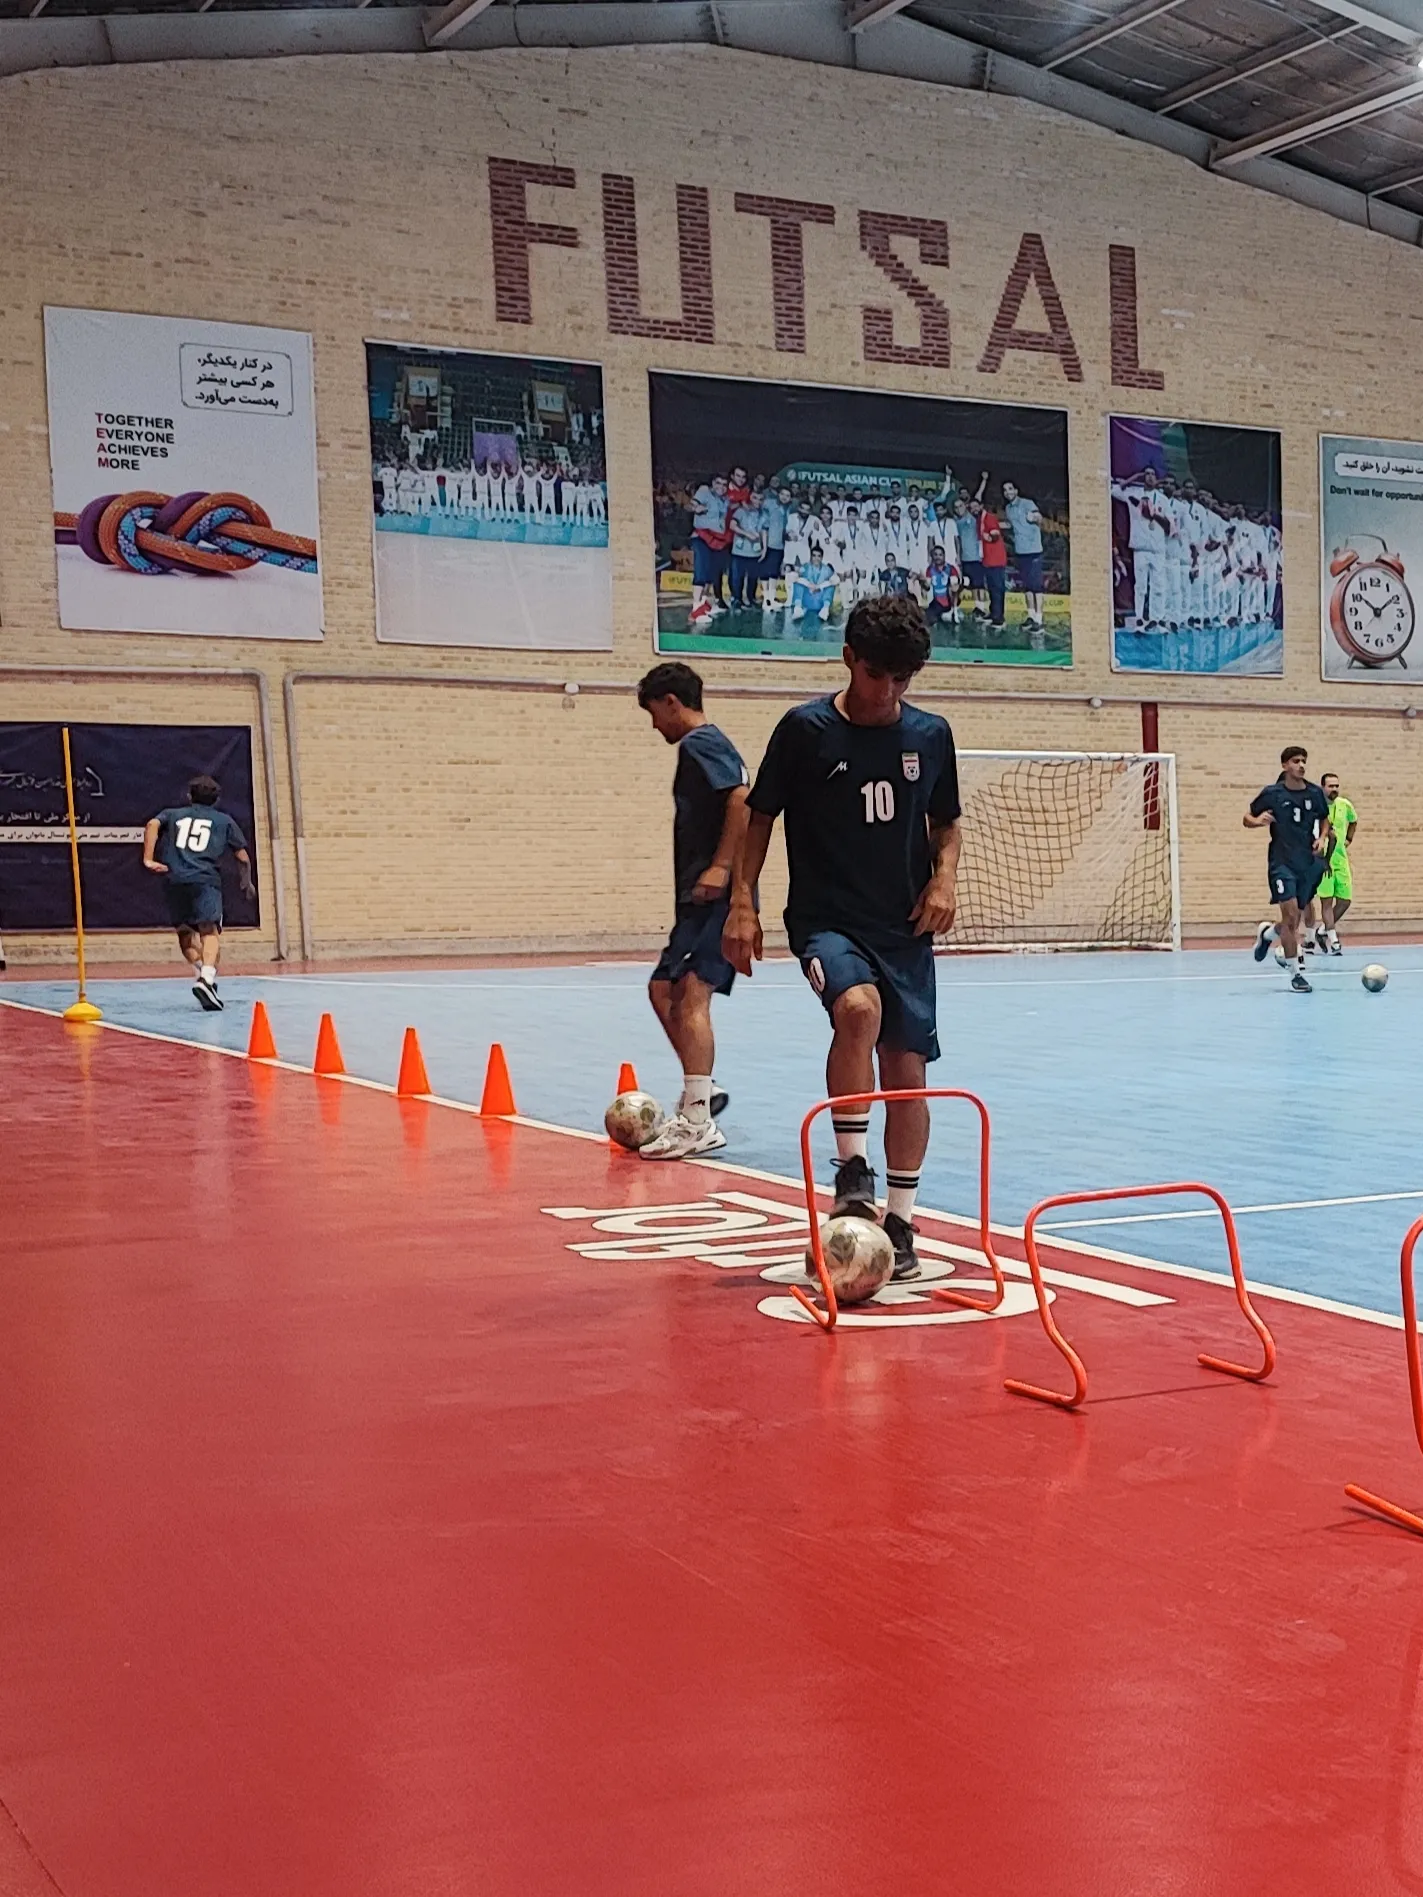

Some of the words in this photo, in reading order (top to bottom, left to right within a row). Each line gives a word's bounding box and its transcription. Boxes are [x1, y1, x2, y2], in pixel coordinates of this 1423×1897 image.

[487, 156, 1164, 390] FUTSAL
[240, 357, 258, 371] کنار
[261, 362, 272, 372] در
[196, 372, 228, 386] بیشتر
[230, 376, 258, 388] کسی
[260, 380, 274, 390] هر
[95, 412, 174, 430] TOGETHER
[96, 428, 174, 444] EVERYONE
[97, 442, 168, 458] ACHIEVES
[98, 457, 140, 470] MORE
[1360, 461, 1374, 472] خلق
[1376, 462, 1380, 472] را
[1382, 461, 1390, 474] آن
[800, 472, 842, 484] FUTSAL
[844, 474, 877, 486] ASIAN
[1330, 485, 1352, 495] Don't
[1354, 488, 1370, 496] wait
[1372, 488, 1383, 498] for
[1360, 582, 1367, 591] 11
[1370, 577, 1381, 588] 12
[1352, 593, 1363, 602] 10
[1392, 594, 1400, 604] 2
[1350, 607, 1358, 616] 9
[1396, 608, 1404, 618] 3
[1354, 620, 1362, 630] 8
[1394, 622, 1402, 632] 4
[1364, 634, 1371, 643] 7
[1374, 638, 1384, 647] 6
[1386, 634, 1394, 644] 5
[861, 780, 895, 823] 10
[1293, 807, 1301, 822] 3
[175, 817, 212, 852] 15
[1276, 878, 1284, 894] 3
